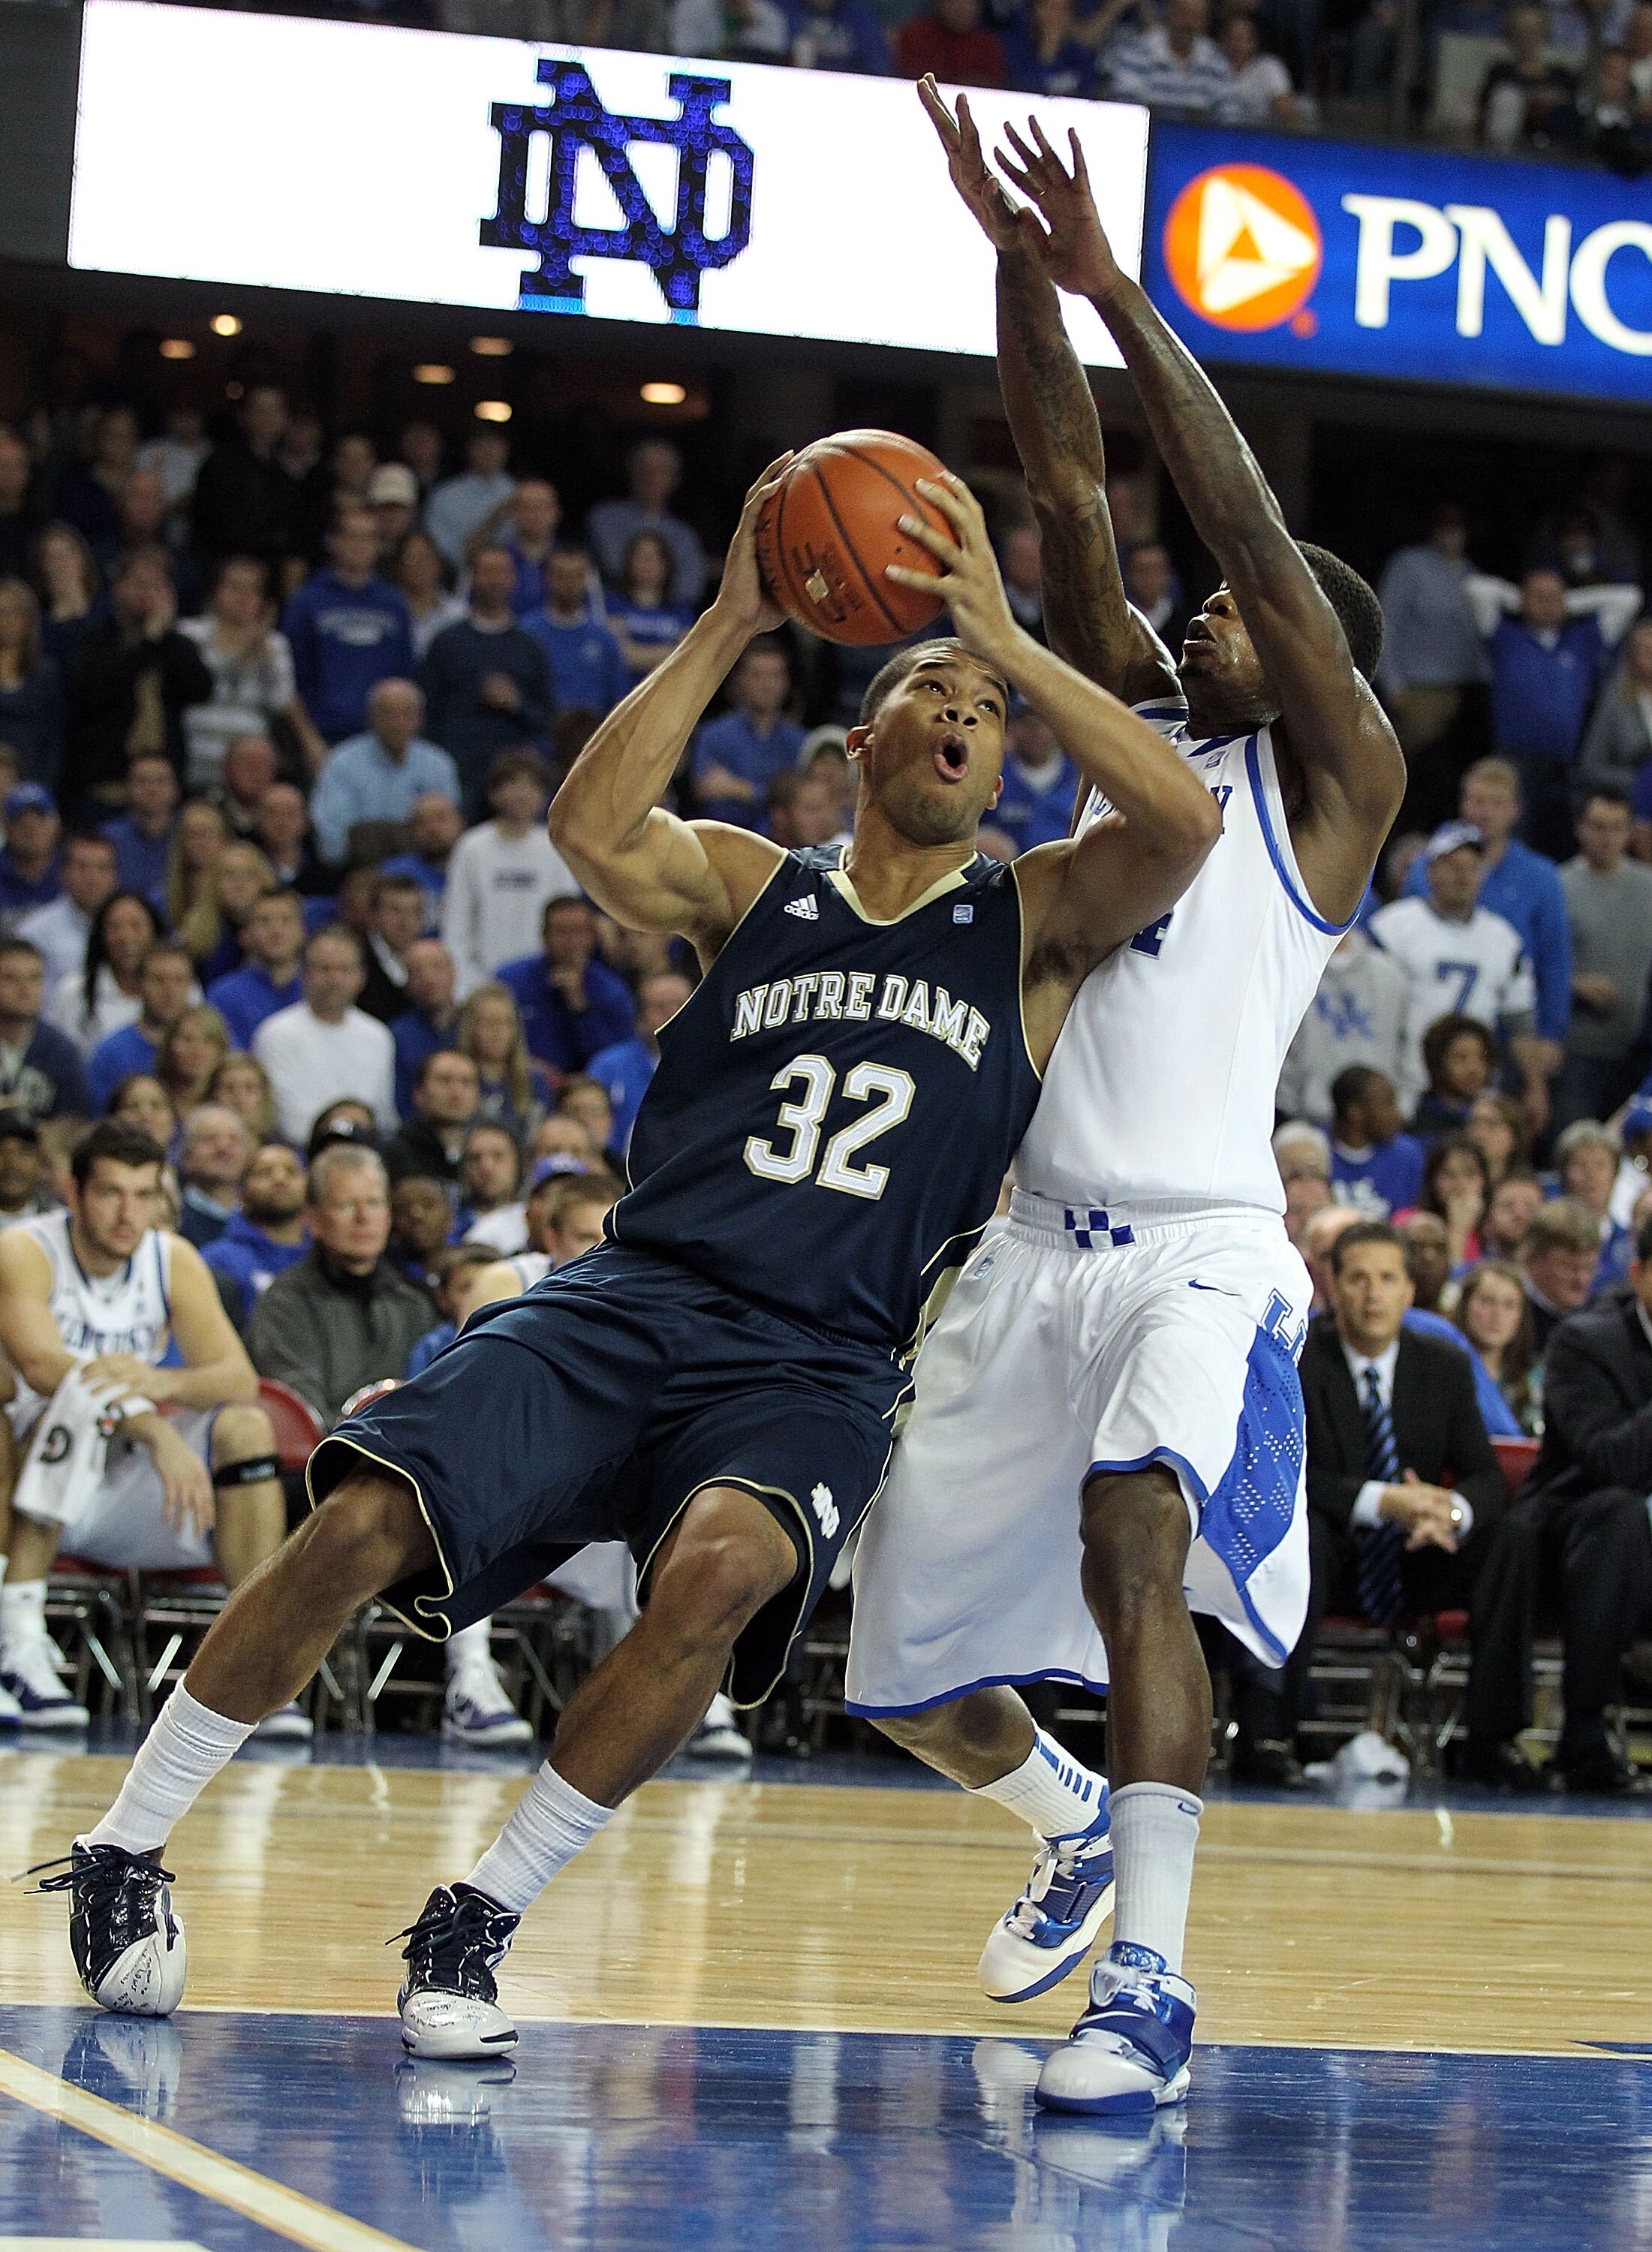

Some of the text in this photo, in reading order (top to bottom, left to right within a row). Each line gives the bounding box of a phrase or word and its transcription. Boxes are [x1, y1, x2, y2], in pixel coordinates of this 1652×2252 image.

[1341, 192, 1652, 357] PNC
[784, 905, 820, 920] adidas
[730, 971, 991, 1071] NOTRE DAME
[742, 1054, 916, 1200] 32
